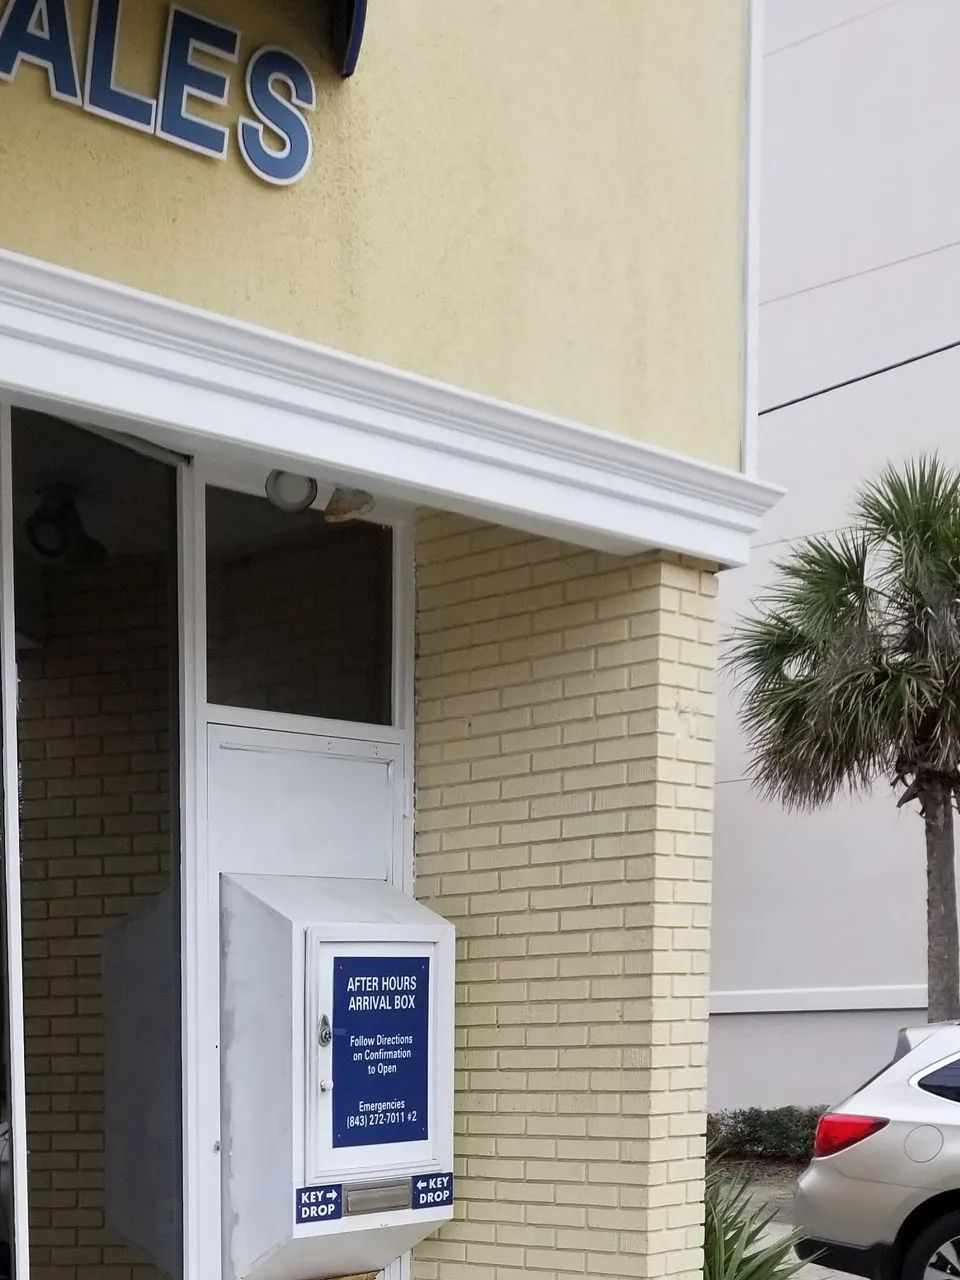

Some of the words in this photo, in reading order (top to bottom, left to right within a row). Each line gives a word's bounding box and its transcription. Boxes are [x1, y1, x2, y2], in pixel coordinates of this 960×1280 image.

[347, 977, 378, 992] AFTER
[382, 976, 416, 990] HOURS
[348, 995, 392, 1010] ARRIVAL
[395, 995, 415, 1009] BOX
[350, 1035, 374, 1047] Follow
[377, 1034, 412, 1045] Directions
[353, 1051, 362, 1061] on
[364, 1049, 411, 1060] Confirmation
[368, 1065, 375, 1074] to
[378, 1064, 396, 1076] Open
[359, 1100, 405, 1114] Emergencies
[347, 1115, 367, 1128] (843)
[369, 1113, 404, 1126] 272-7011
[408, 1111, 417, 1122] #2
[429, 1177, 449, 1189] KEY
[301, 1191, 324, 1203] KEY
[419, 1190, 450, 1204] DROP
[301, 1204, 335, 1218] DROP
